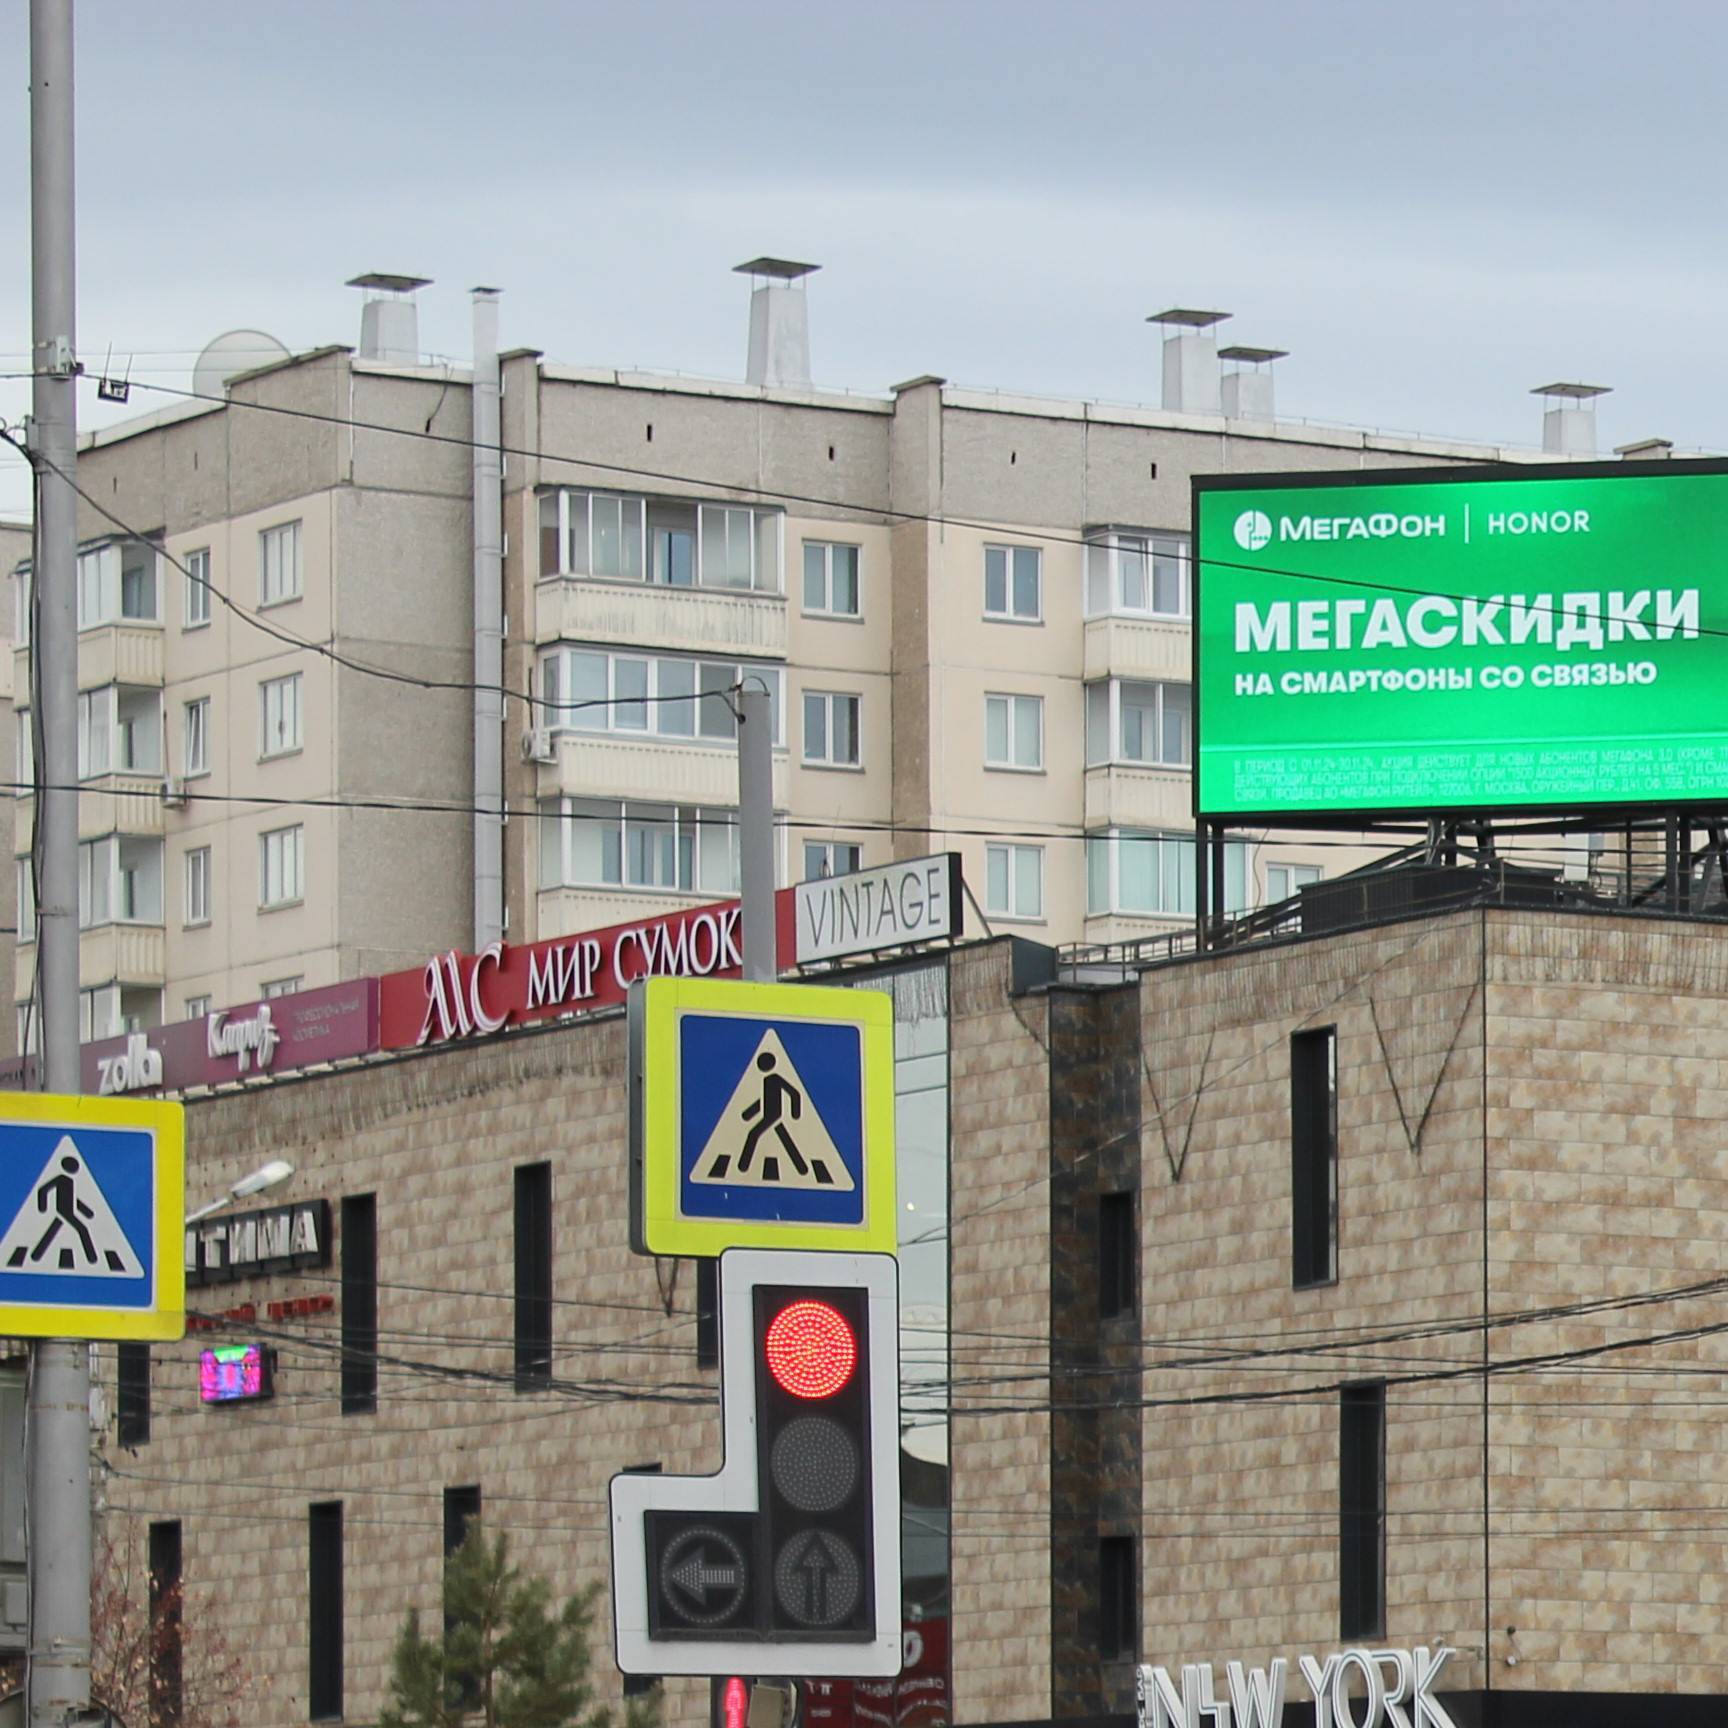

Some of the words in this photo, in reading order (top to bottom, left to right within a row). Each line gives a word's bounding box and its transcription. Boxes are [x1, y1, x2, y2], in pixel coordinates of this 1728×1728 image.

[1487, 509, 1591, 535] HONOR
[1234, 588, 1701, 653] МЕГАСКИДКИ
[1234, 673, 1275, 696] НА
[1279, 665, 1473, 695] СМАРТФОНЫ
[1479, 665, 1525, 688] СО
[1530, 661, 1658, 688] СВЯЗЬЮ
[806, 867, 942, 948] VINTAGE
[526, 943, 601, 1010] МИР
[612, 907, 743, 991] СУМОК
[97, 1033, 164, 1096] zolla
